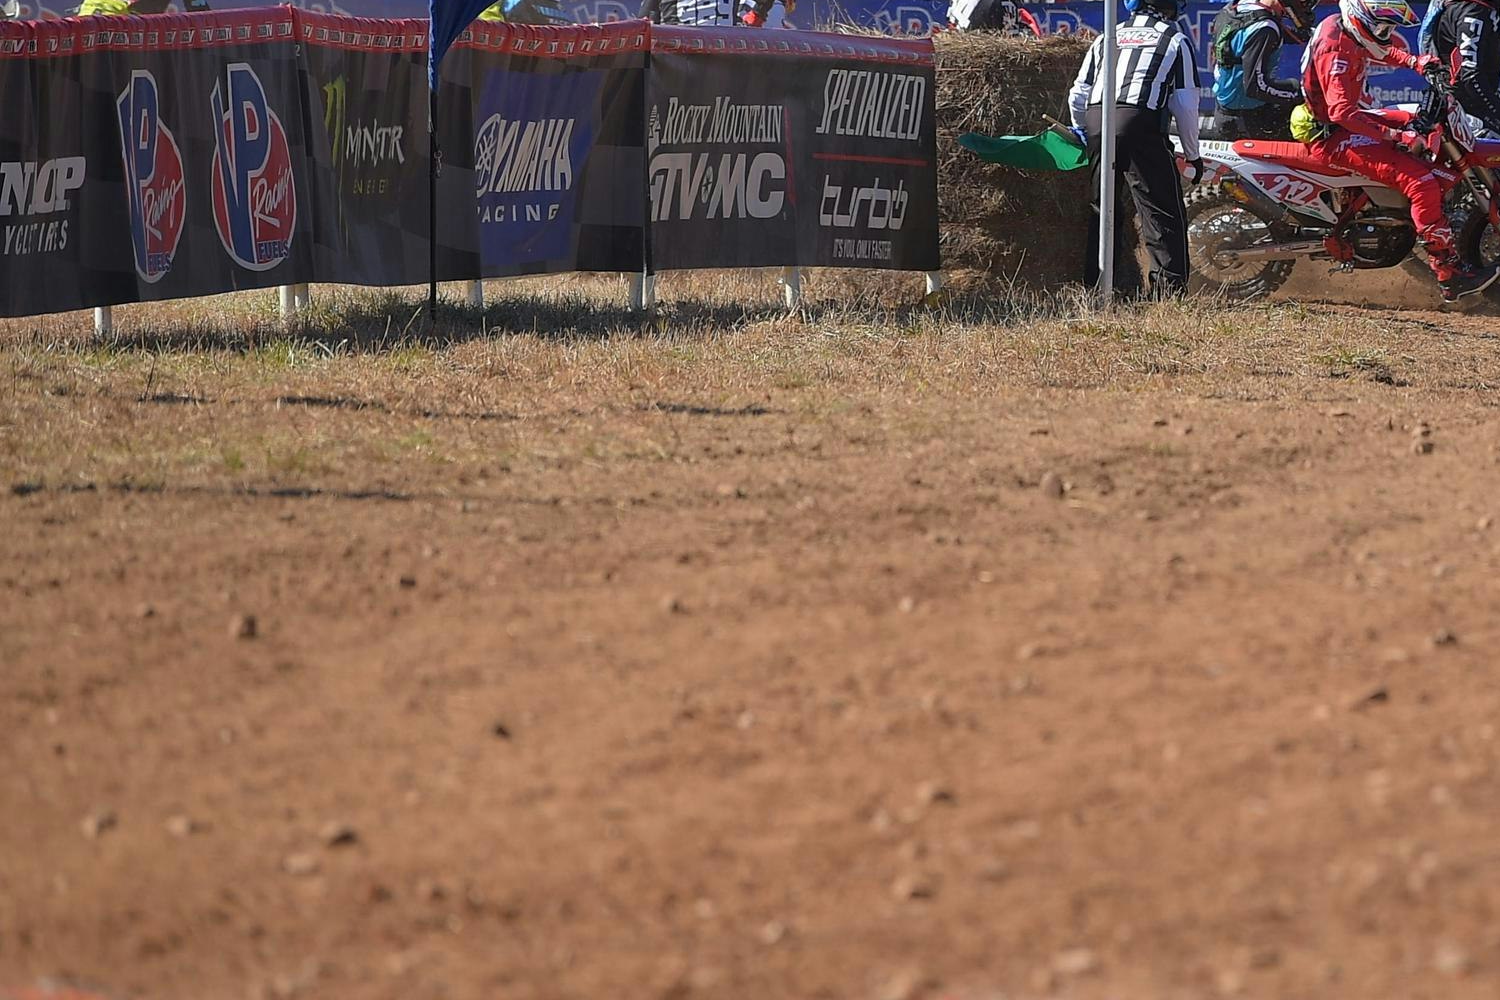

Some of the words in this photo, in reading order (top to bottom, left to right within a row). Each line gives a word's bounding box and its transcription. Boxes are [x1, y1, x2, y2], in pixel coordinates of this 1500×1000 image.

[660, 96, 712, 145] ROCKY
[705, 96, 784, 144] MOUNTAIN
[815, 68, 926, 140] SPECIALIZED
[210, 62, 272, 266] VP
[1203, 151, 1243, 163] DUNLOP
[819, 174, 910, 231] turbo
[1266, 174, 1315, 203] 212
